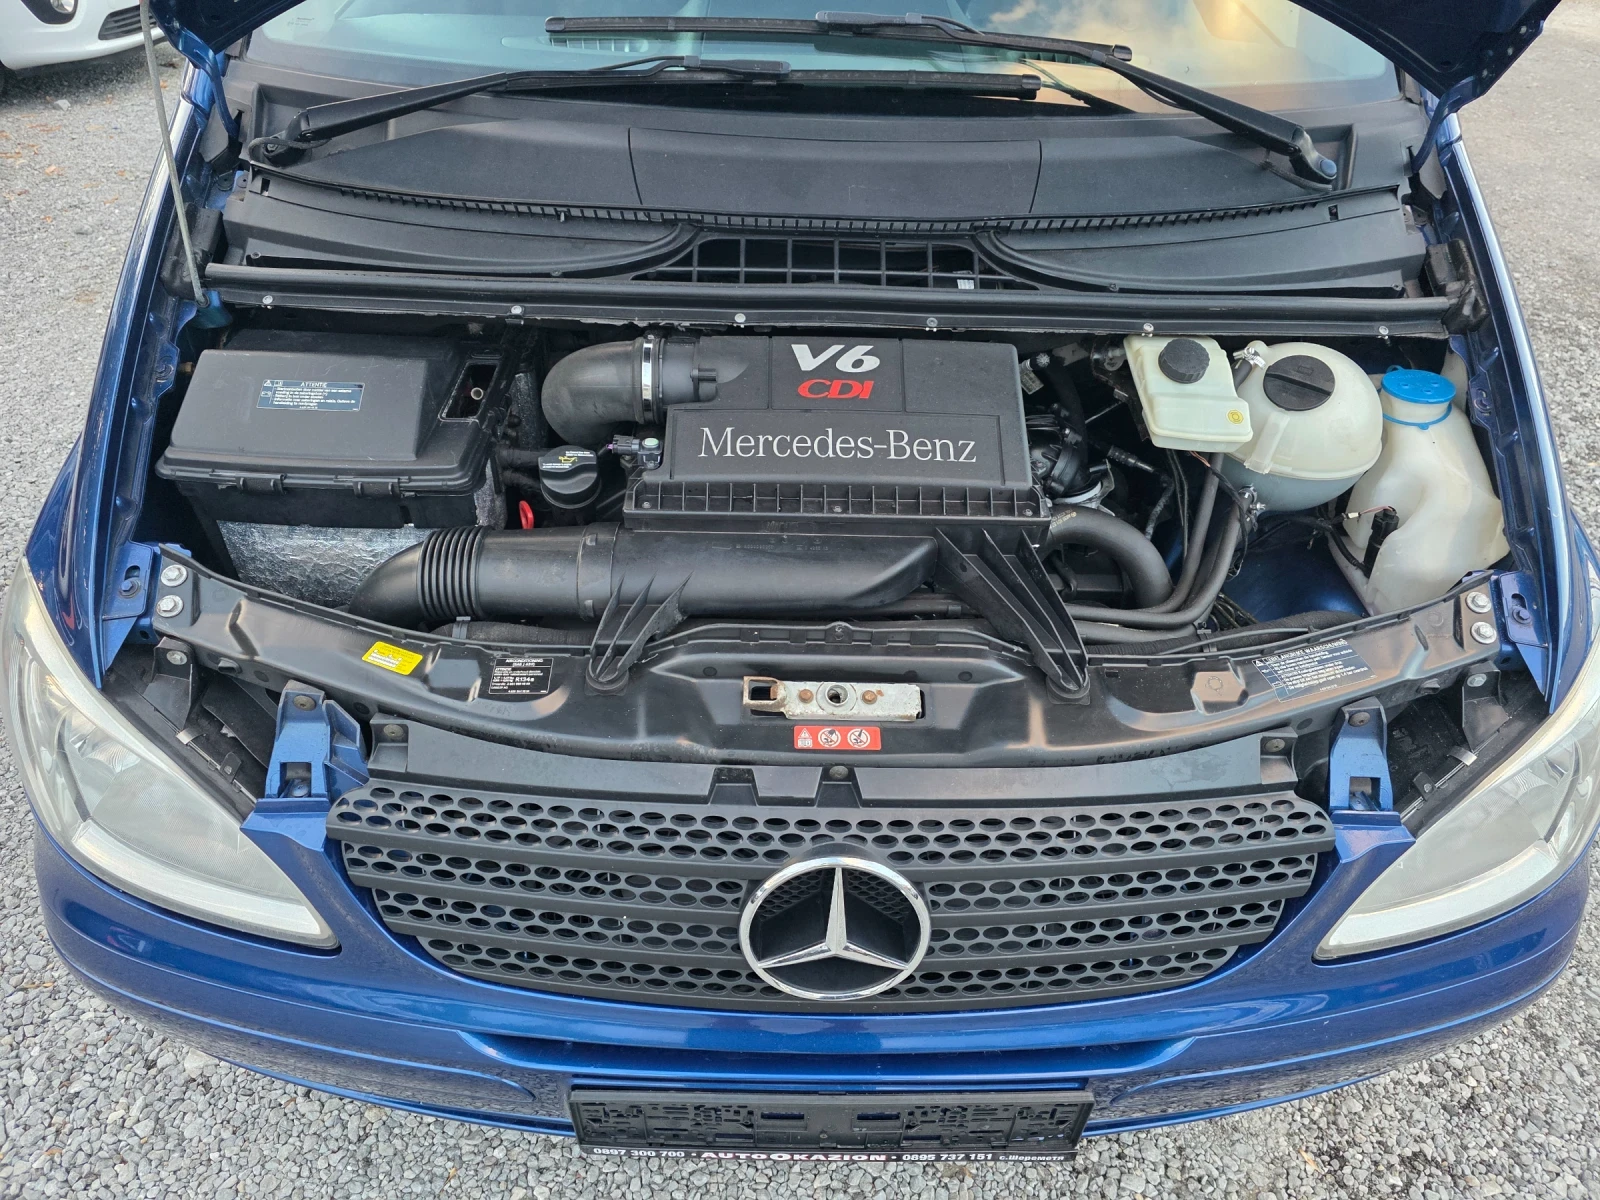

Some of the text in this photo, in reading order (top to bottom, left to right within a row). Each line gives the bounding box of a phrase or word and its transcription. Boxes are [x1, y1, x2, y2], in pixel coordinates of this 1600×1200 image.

[791, 344, 880, 373] V6
[797, 379, 874, 399] CDI
[698, 426, 977, 463] Mercedes-Benz
[701, 1152, 886, 1161] AUTOOKAZION
